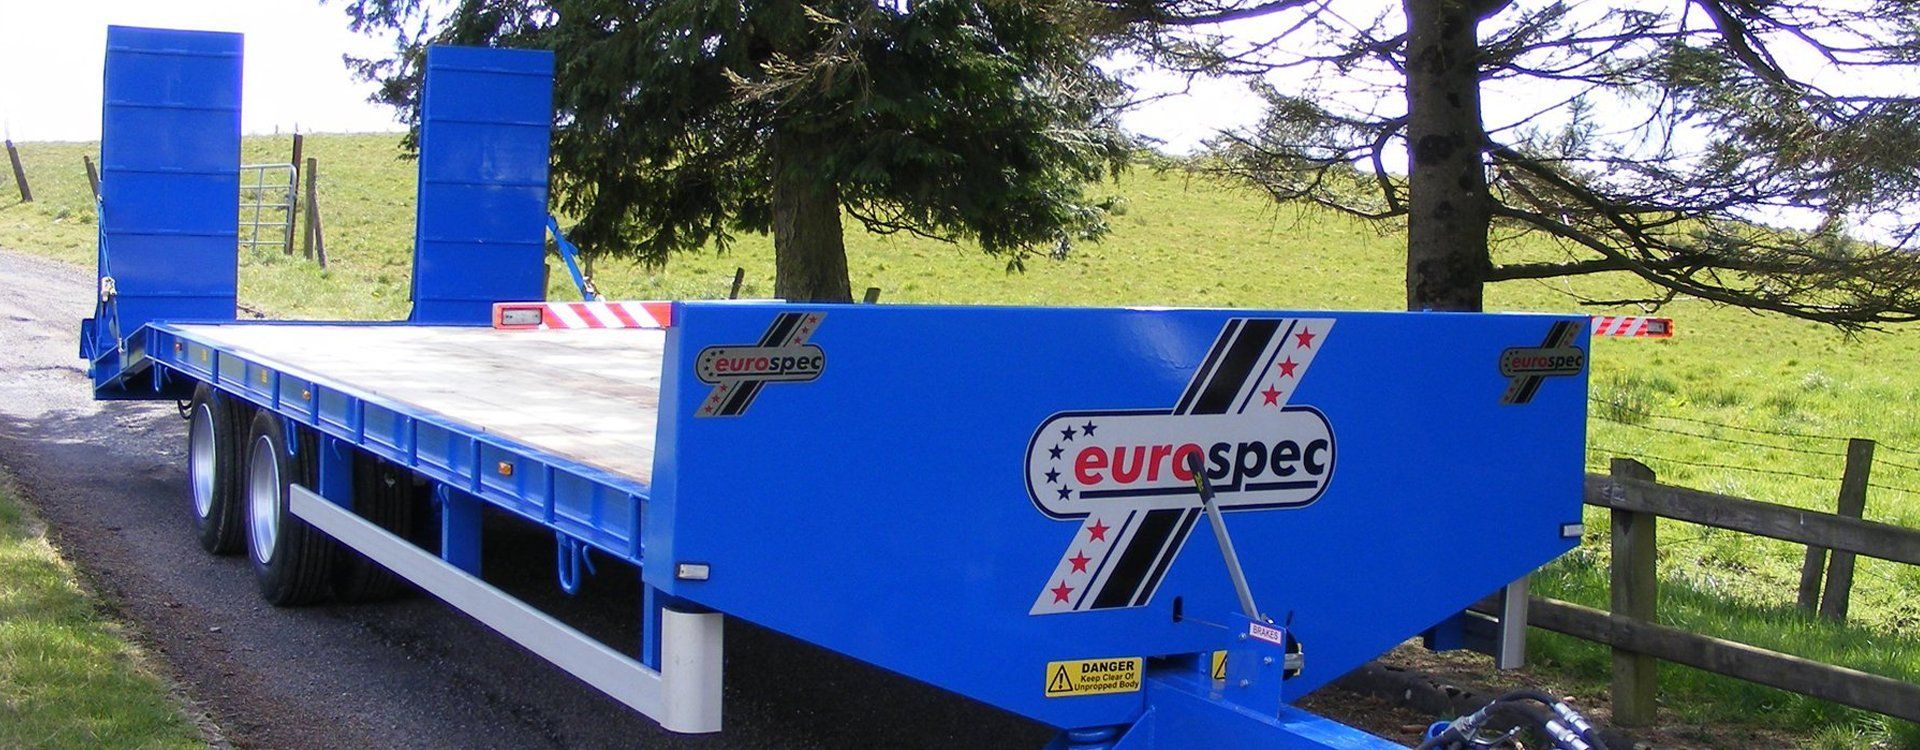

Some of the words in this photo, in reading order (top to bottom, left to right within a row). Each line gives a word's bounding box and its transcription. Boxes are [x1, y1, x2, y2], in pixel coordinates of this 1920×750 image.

[715, 356, 822, 375] eurospec
[1511, 355, 1582, 370] eurospec
[1074, 438, 1329, 492] eurospec
[1253, 625, 1279, 641] BRAKES
[1082, 661, 1135, 674] DANGER
[1080, 673, 1101, 683] Keep
[1102, 672, 1123, 682] Clear
[1124, 672, 1135, 681] Of
[1074, 681, 1118, 692] Unpropped
[1119, 680, 1140, 689] Body
